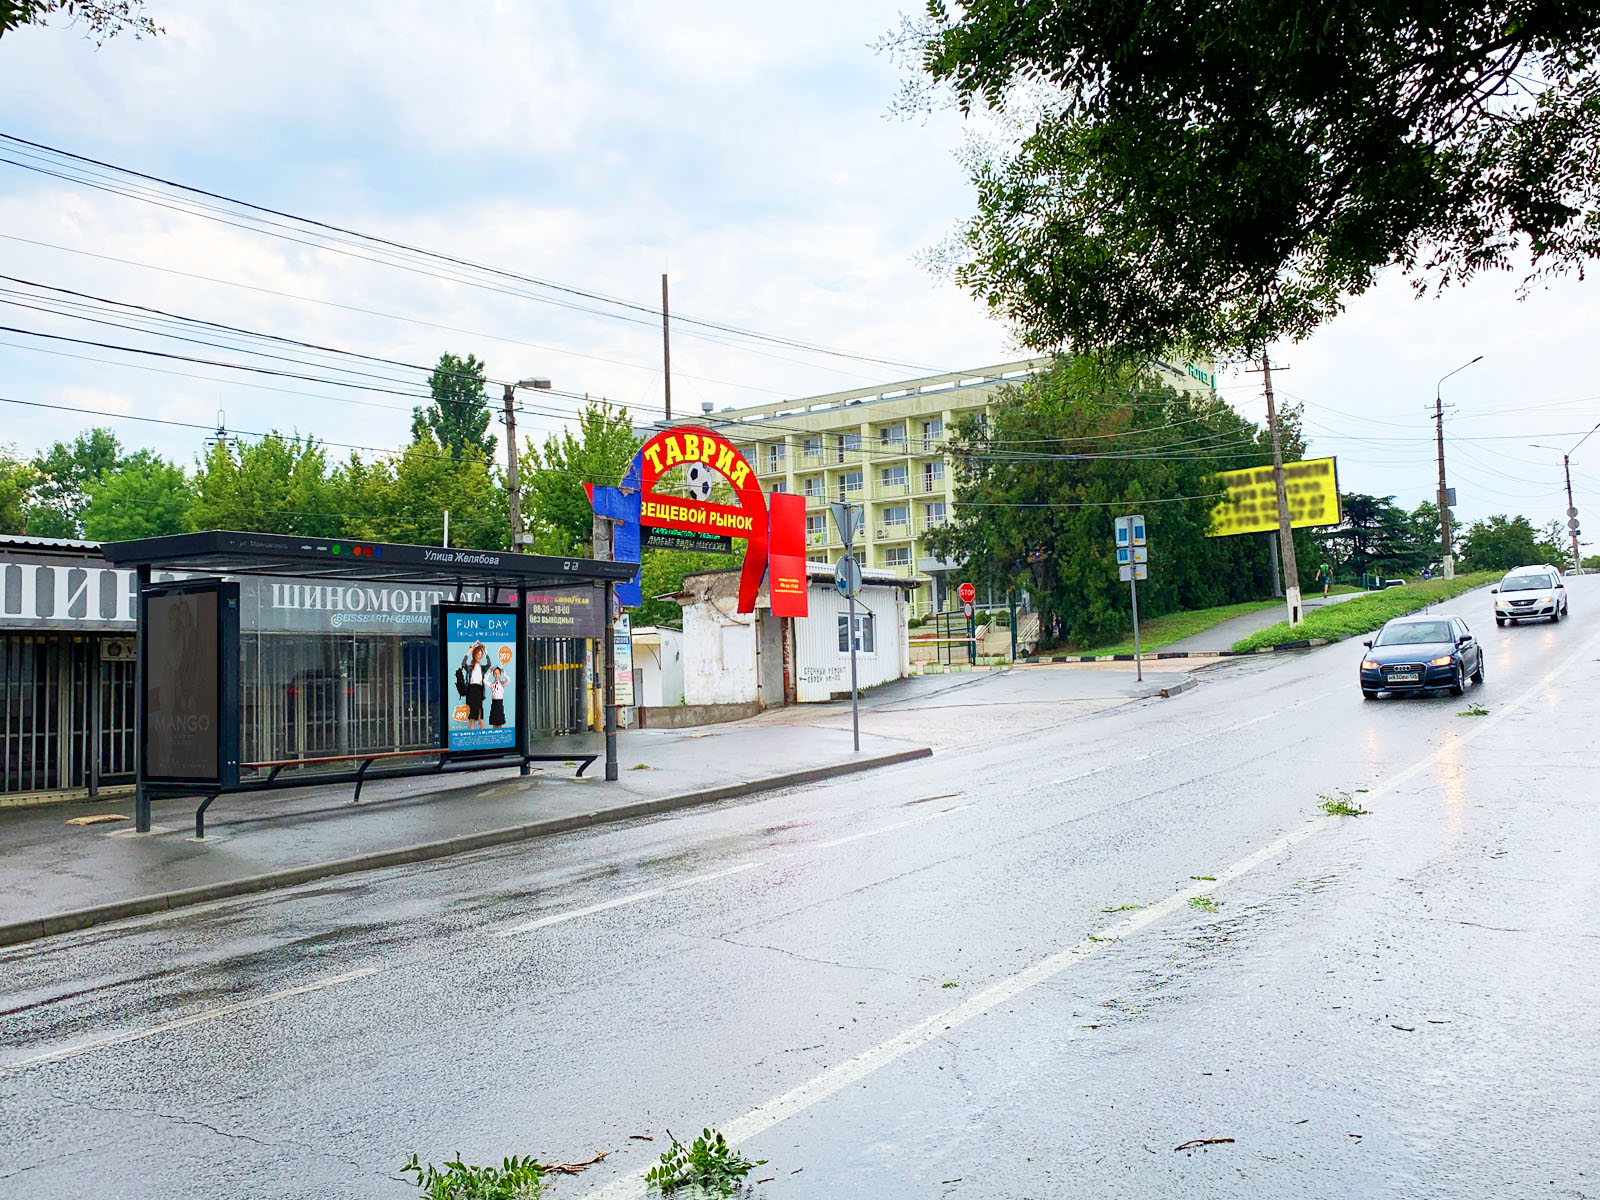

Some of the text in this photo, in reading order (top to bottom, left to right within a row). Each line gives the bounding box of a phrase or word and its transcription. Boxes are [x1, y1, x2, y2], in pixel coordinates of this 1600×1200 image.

[644, 433, 750, 490] ТАВРИЯ
[641, 501, 753, 530] ВЕЩЕВОЙ РЫНОК
[424, 550, 500, 565] Улица Желябова
[456, 619, 509, 630] FUN DAY
[529, 614, 575, 625] без выходных
[154, 713, 211, 730] MANGO
